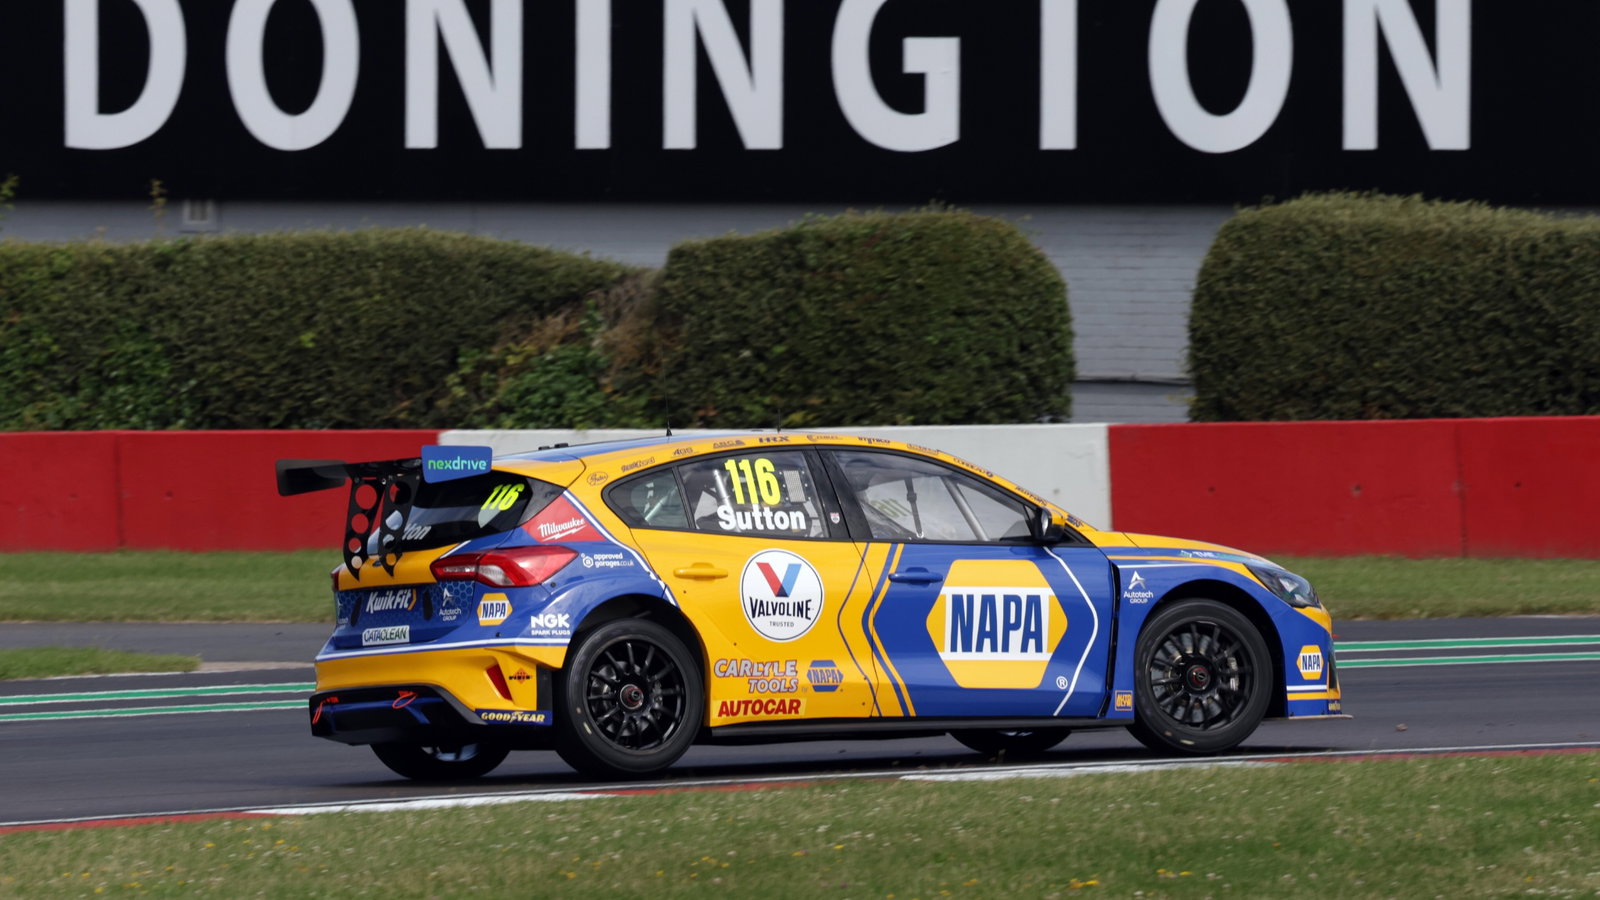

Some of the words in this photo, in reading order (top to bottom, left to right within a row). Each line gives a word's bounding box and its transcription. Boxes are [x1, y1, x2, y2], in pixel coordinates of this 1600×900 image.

[427, 456, 487, 470] nexdrive
[724, 458, 781, 505] 116
[480, 483, 525, 511] 116
[716, 504, 807, 531] Sutton
[537, 517, 586, 537] Milwaukee
[593, 552, 624, 561] approved
[1123, 591, 1154, 599] Autotech
[439, 607, 462, 616] Autotech
[482, 603, 507, 618] NAPA
[749, 597, 812, 621] VALVOLINE
[530, 613, 570, 629] NGK
[950, 594, 1043, 653] NAPA
[363, 627, 407, 642] CATACLEAN
[714, 658, 798, 678] CARLYLE
[1301, 655, 1322, 671] NAPA
[811, 668, 839, 684] NAPA
[748, 678, 799, 693] TOOLS
[717, 698, 802, 718] AUTOCAR
[481, 711, 546, 723] GOODYEAR
